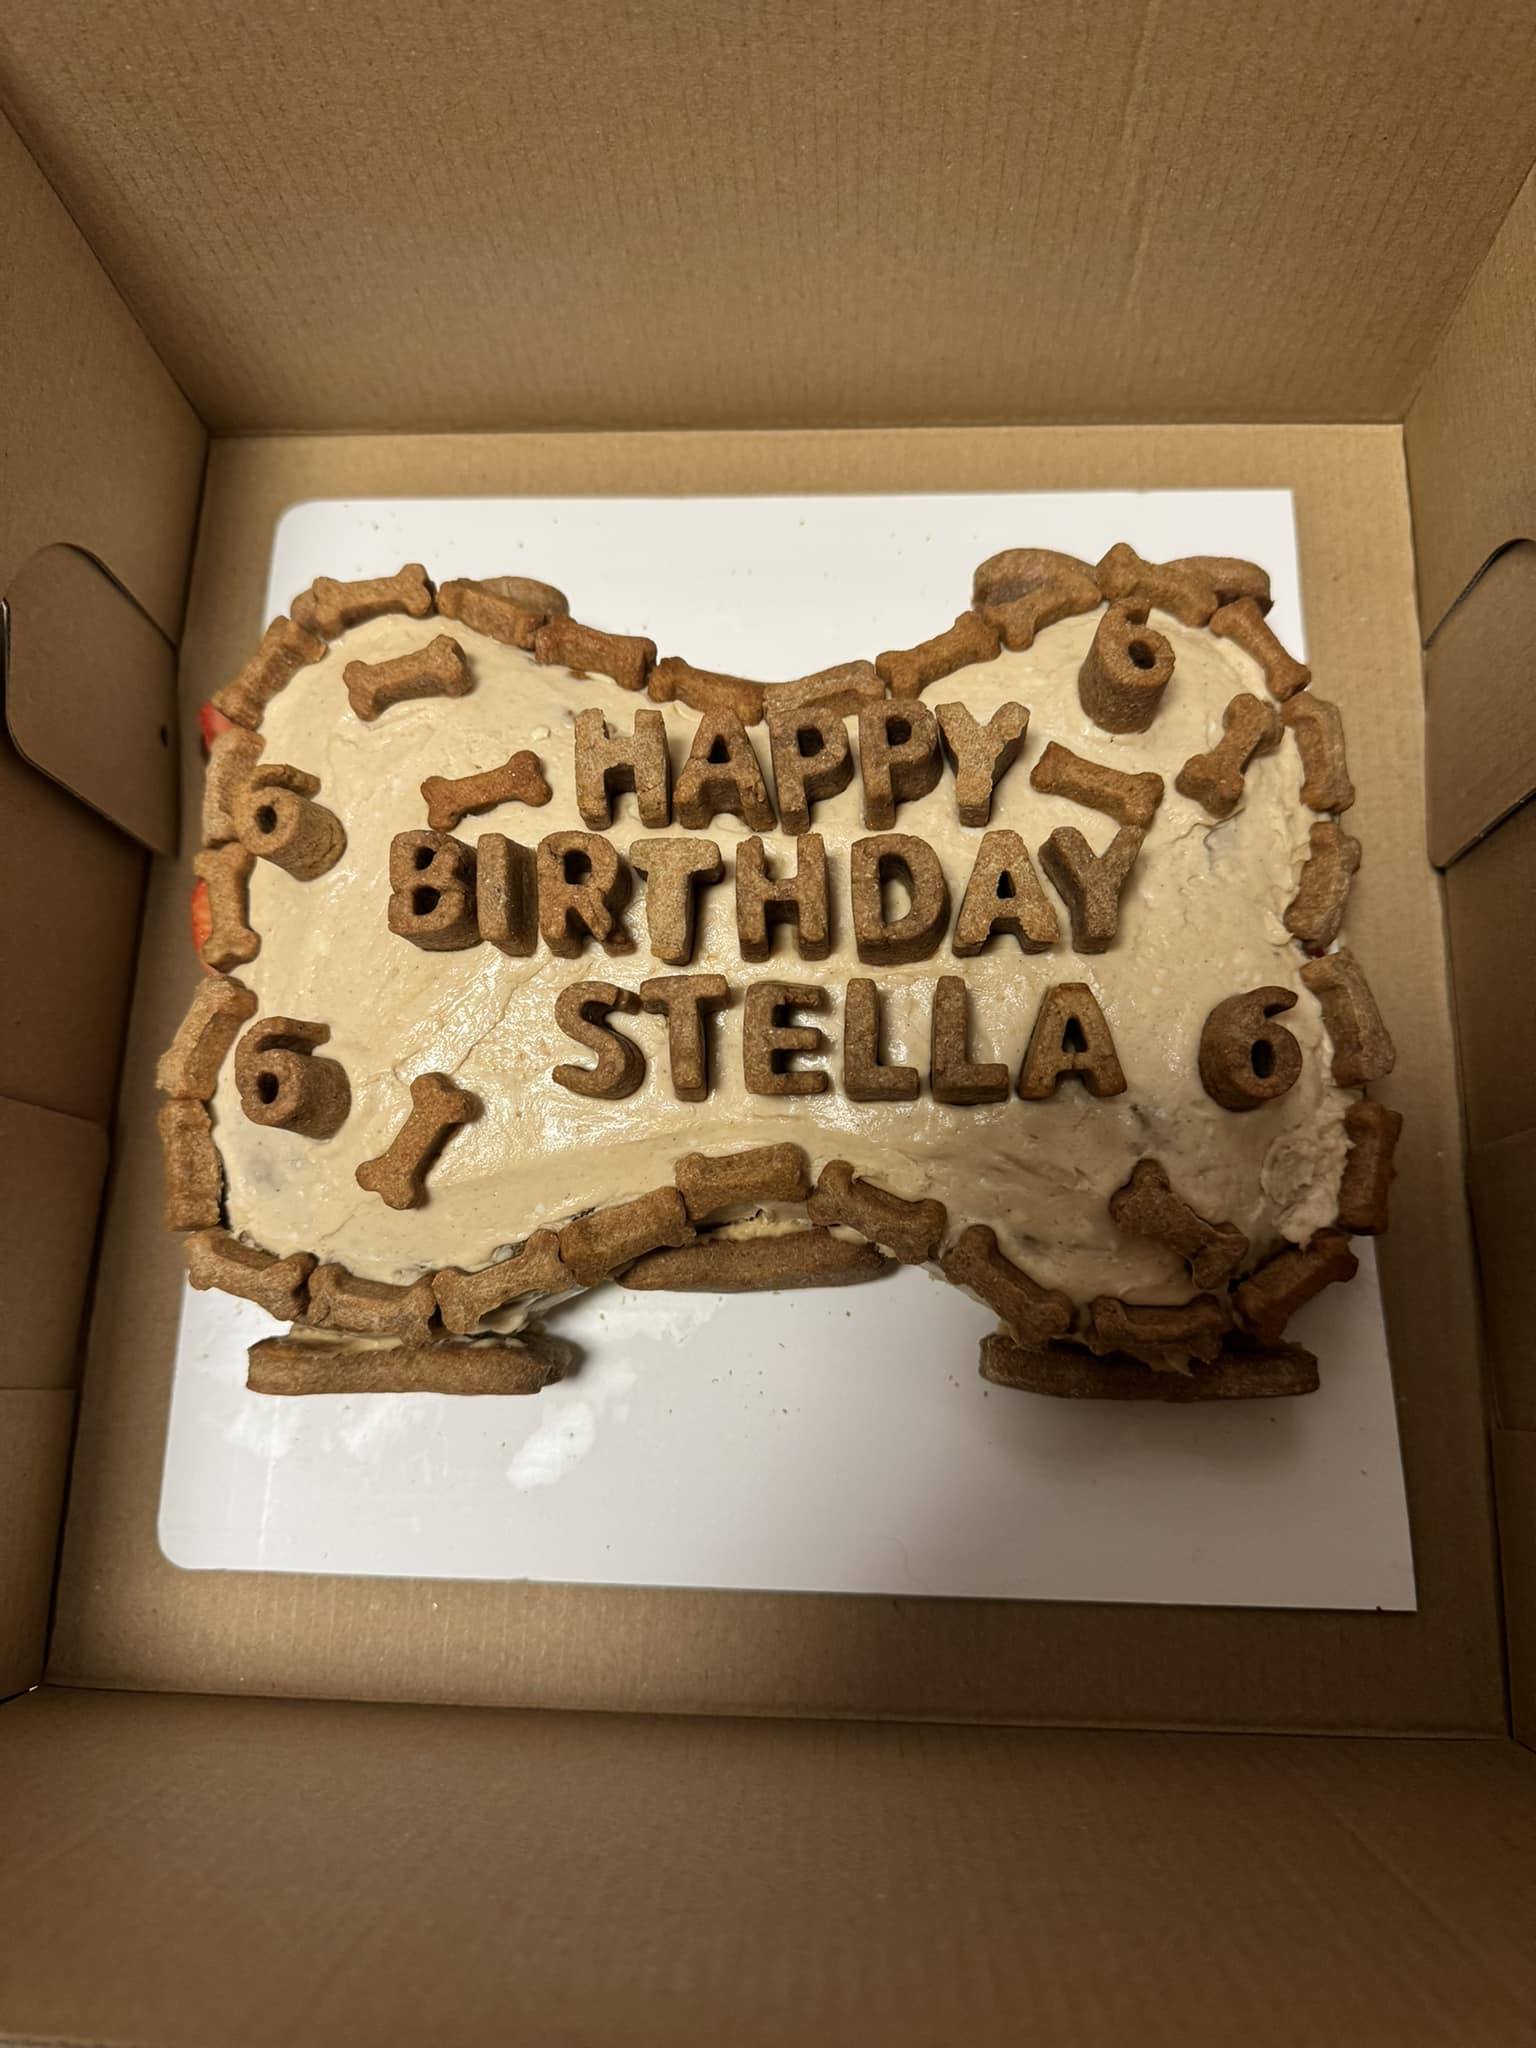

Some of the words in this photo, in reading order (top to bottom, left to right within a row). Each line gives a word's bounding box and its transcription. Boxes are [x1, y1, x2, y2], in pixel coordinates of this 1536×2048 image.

[1078, 598, 1176, 735] 6
[233, 764, 347, 882] 6
[574, 698, 1031, 834] HAPPY
[388, 825, 1145, 966] BIRTHDAY
[234, 1016, 352, 1140] 6
[552, 972, 1127, 1103] STELLA
[1198, 986, 1303, 1112] 6
